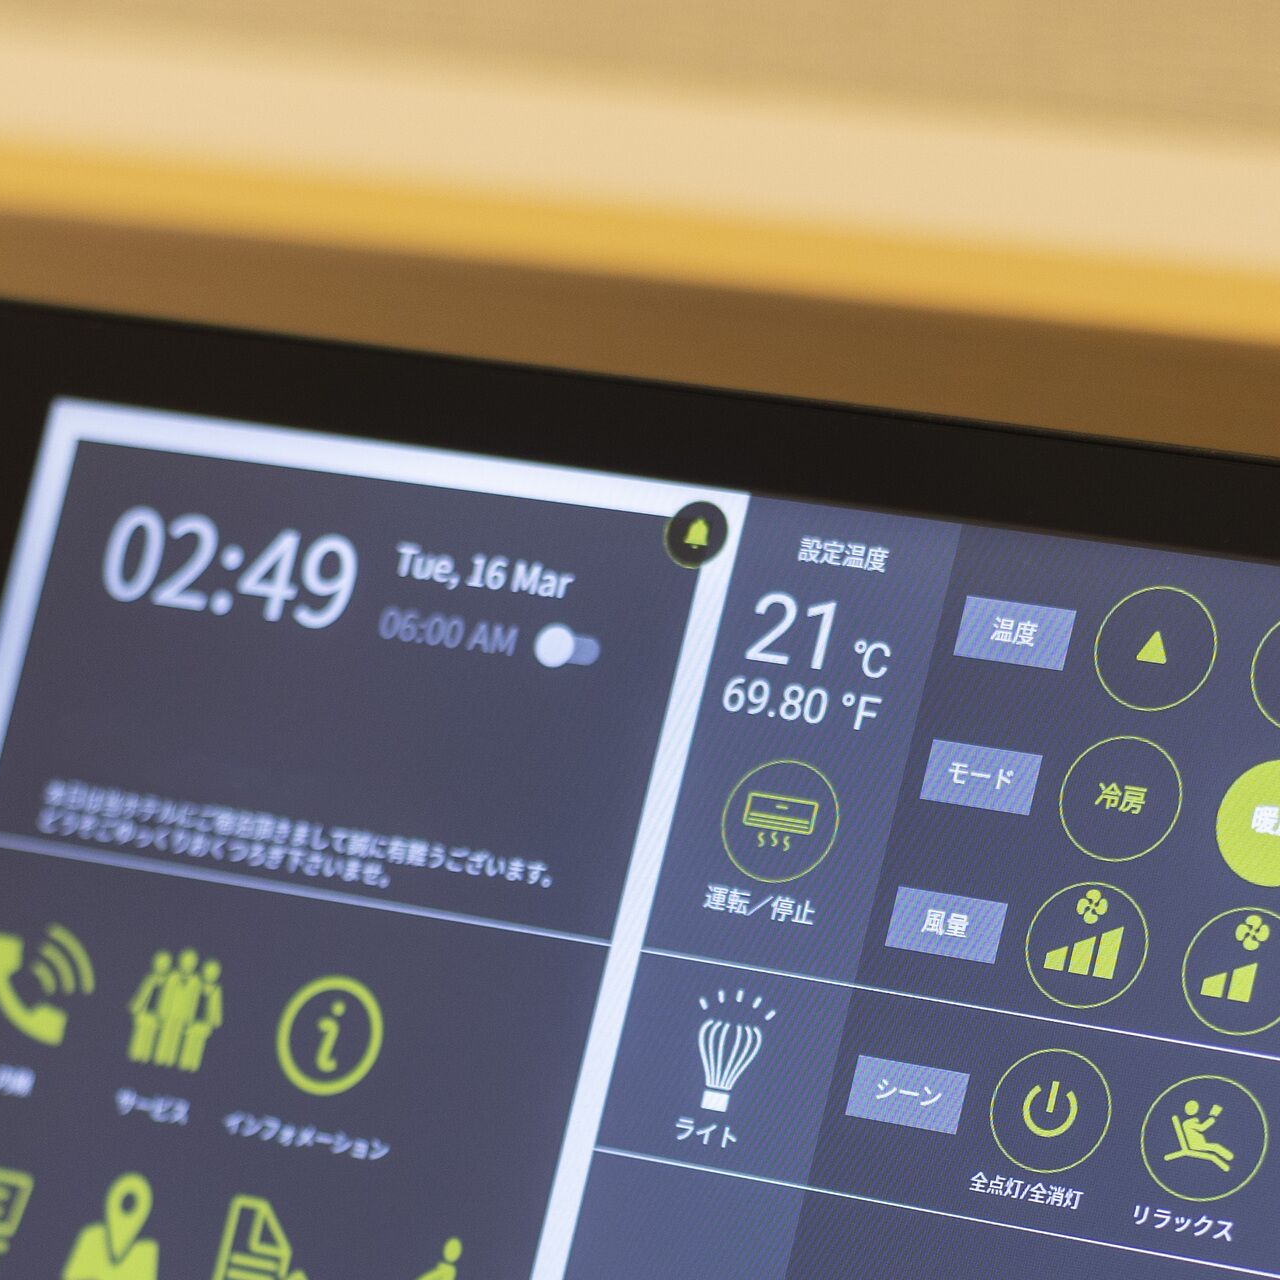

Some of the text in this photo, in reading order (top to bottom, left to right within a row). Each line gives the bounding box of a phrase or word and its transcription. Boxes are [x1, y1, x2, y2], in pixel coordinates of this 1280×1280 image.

[102, 506, 359, 630] 02:49
[397, 541, 576, 600] Tue, 16 Mar
[797, 536, 890, 573] 設定温度
[377, 605, 519, 658] 06:00 AM
[745, 592, 838, 671] 21
[989, 616, 1039, 648] 温度
[721, 676, 828, 724] 69.80
[948, 761, 1015, 790] モード
[1094, 782, 1148, 815] 冷房
[920, 908, 970, 939] 風量
[115, 1088, 191, 1126] サービス
[874, 1074, 943, 1107] シーン
[223, 1110, 391, 1162] インフォメーション
[674, 1116, 737, 1149] ライト
[1132, 1204, 1234, 1242] リラックス
